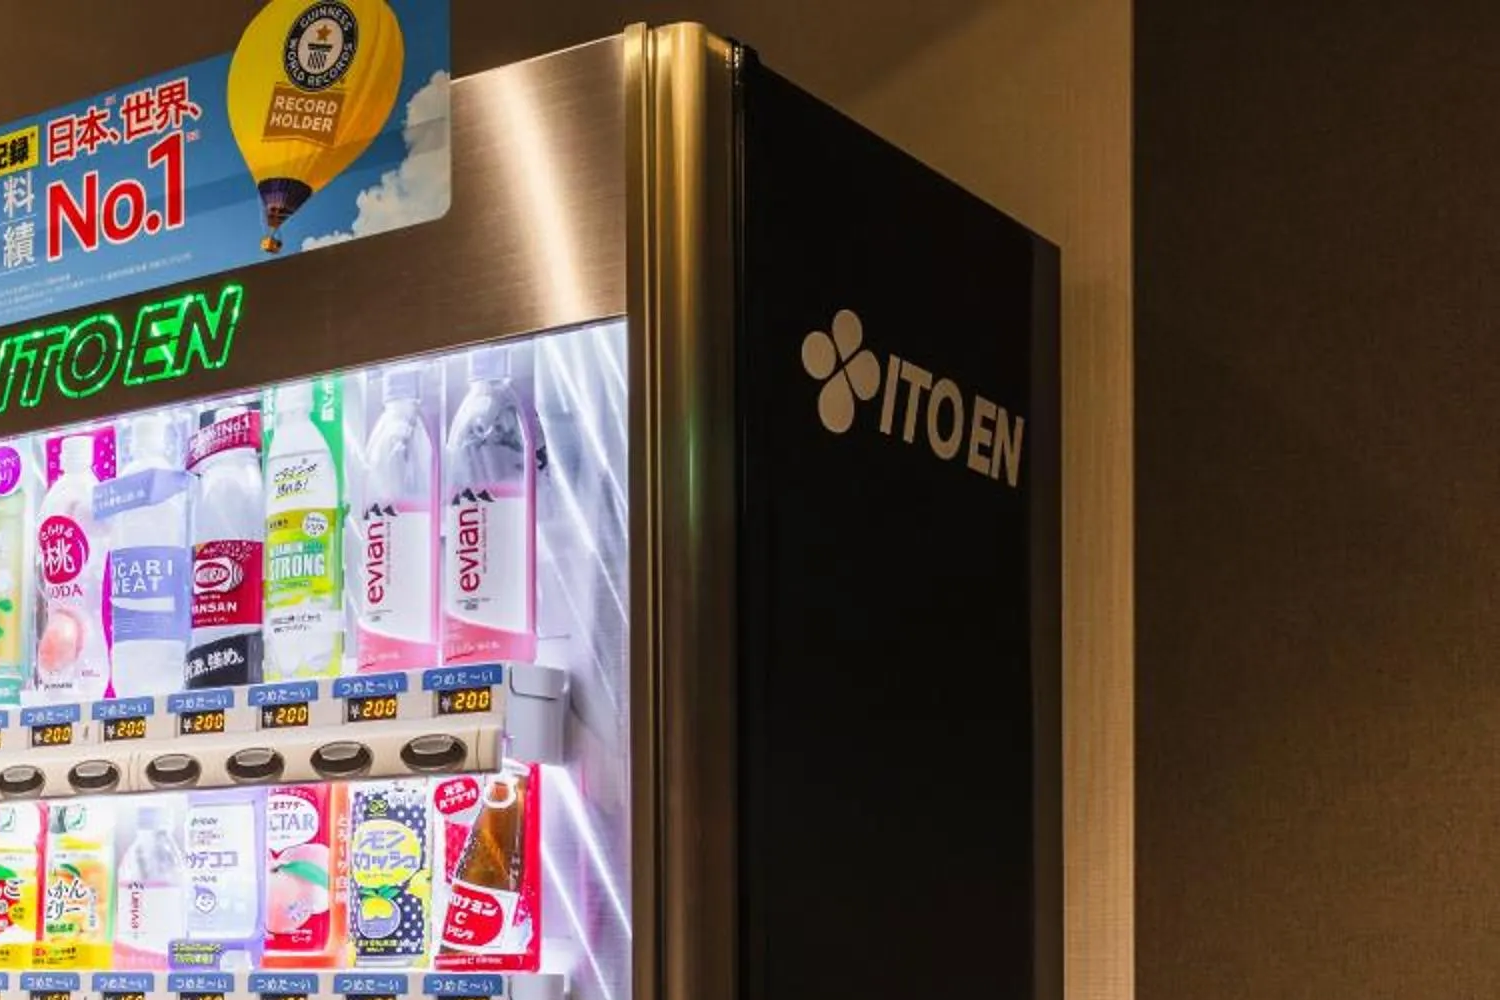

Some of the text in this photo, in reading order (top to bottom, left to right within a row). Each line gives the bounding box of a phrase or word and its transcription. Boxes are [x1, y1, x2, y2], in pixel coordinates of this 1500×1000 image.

[273, 95, 339, 116] RECORD
[269, 112, 334, 134] HOLDER
[46, 128, 185, 263] No.1
[123, 284, 244, 386] EN
[879, 353, 1025, 488] ITO EN
[44, 539, 76, 575] 桃
[457, 504, 481, 594] evian
[113, 559, 174, 578] CARI
[366, 520, 385, 605] evian
[50, 583, 83, 599] ODA
[113, 576, 162, 593] EAT
[192, 601, 238, 614] ANSAN
[455, 911, 468, 926] C
